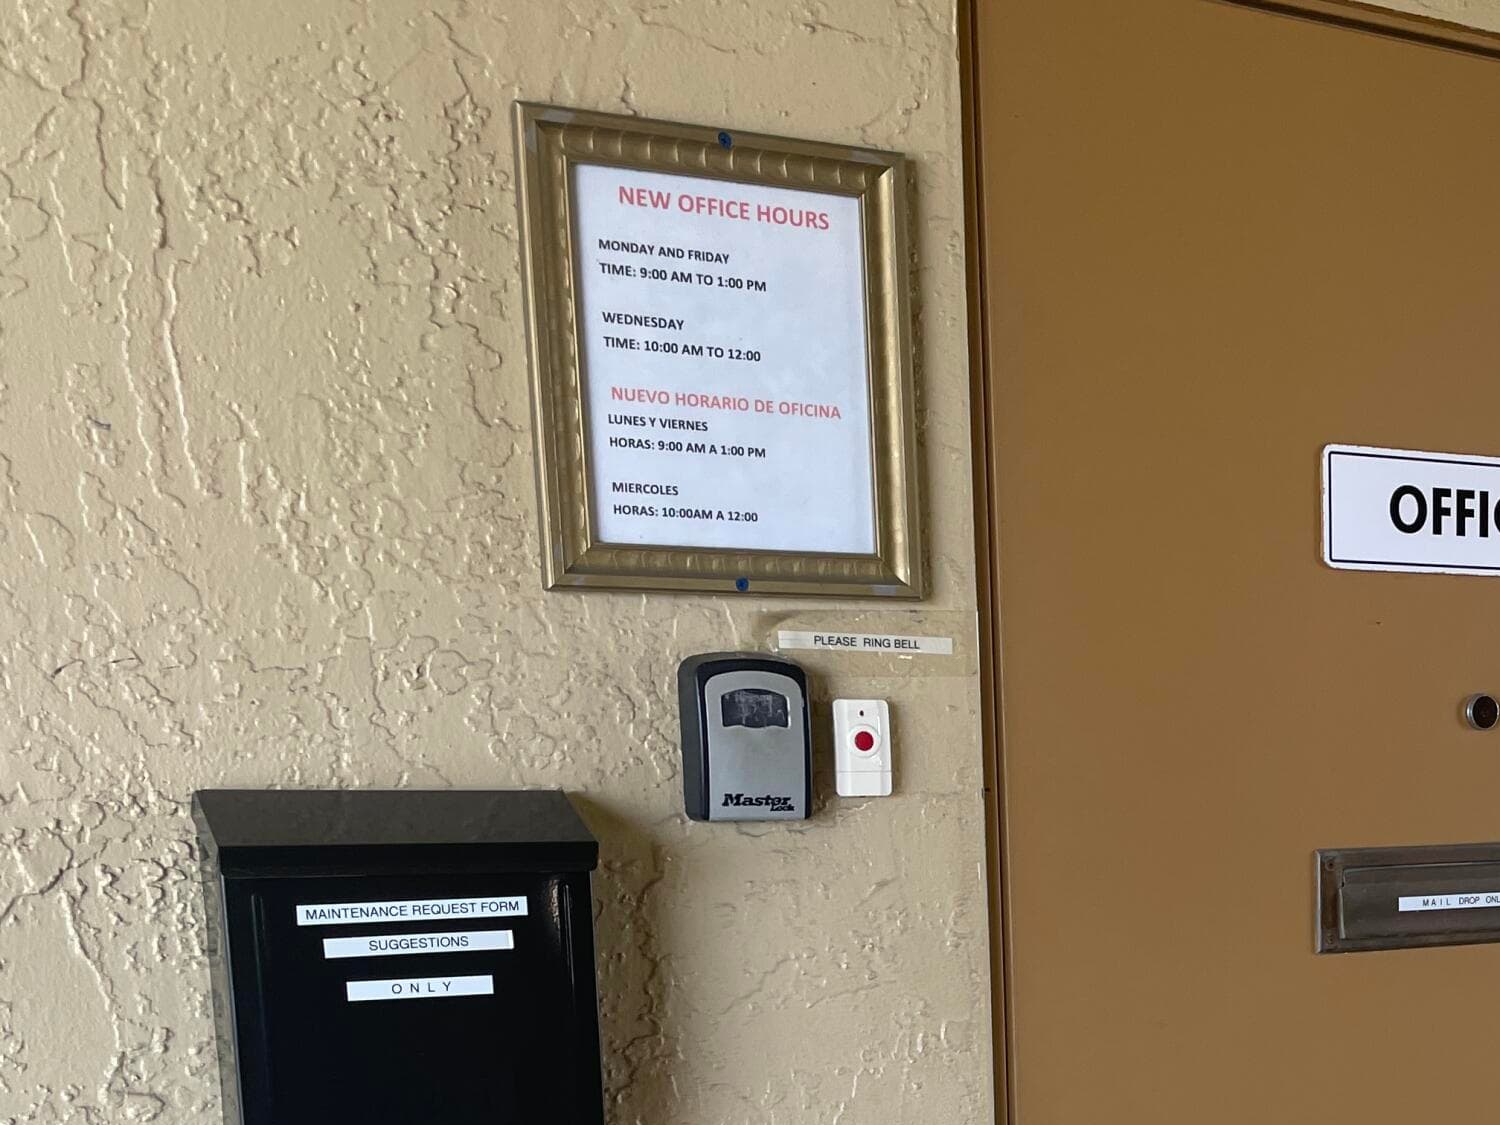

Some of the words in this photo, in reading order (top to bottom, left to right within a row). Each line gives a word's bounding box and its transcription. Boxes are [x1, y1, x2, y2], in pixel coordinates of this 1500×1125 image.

[618, 186, 671, 210] NEW
[678, 194, 750, 220] OFFICE
[757, 205, 830, 230] HOURS
[598, 239, 655, 256] MONDAY
[658, 247, 685, 259] AND
[688, 250, 729, 264] FRIDAY
[600, 263, 637, 277] TIME:
[640, 268, 667, 280] 9:00
[670, 272, 692, 283] AM
[696, 274, 714, 285] TO
[718, 277, 743, 289] 1:00
[746, 280, 767, 292] PM
[602, 312, 684, 330] WEDNESDAY
[603, 337, 640, 350] TIME:
[644, 341, 679, 354] 10:00
[681, 345, 703, 356] AM
[707, 347, 724, 358] TO
[728, 349, 761, 362] 12:00
[611, 387, 670, 404] NUEVO
[675, 393, 749, 411] HORARIO
[755, 400, 774, 413] DE
[779, 402, 841, 419] OFICINA
[608, 414, 646, 427] LUNES
[649, 418, 656, 427] Y
[659, 418, 708, 431] VIERNES
[609, 437, 655, 450] HORAS:
[658, 441, 683, 452] 9:00
[686, 443, 706, 453] AM
[709, 445, 717, 454] A
[721, 446, 744, 456] 1:00
[748, 448, 766, 458] PM
[612, 482, 679, 495] MIERCOLES
[613, 505, 658, 517] HORAS:
[662, 508, 713, 519] 10:00AM
[716, 511, 724, 520] A
[728, 511, 758, 522] 12:00
[814, 636, 857, 646] PLEASE
[864, 638, 890, 648] RING
[894, 640, 920, 649] BELL
[722, 794, 791, 806] Master
[1459, 896, 1480, 904] DROP
[305, 906, 407, 920] MAINTENANCE
[412, 902, 476, 915] REQUEST
[481, 901, 520, 912] FORM
[369, 936, 469, 951] SUGGESTIONS
[392, 982, 451, 994] ONLY
